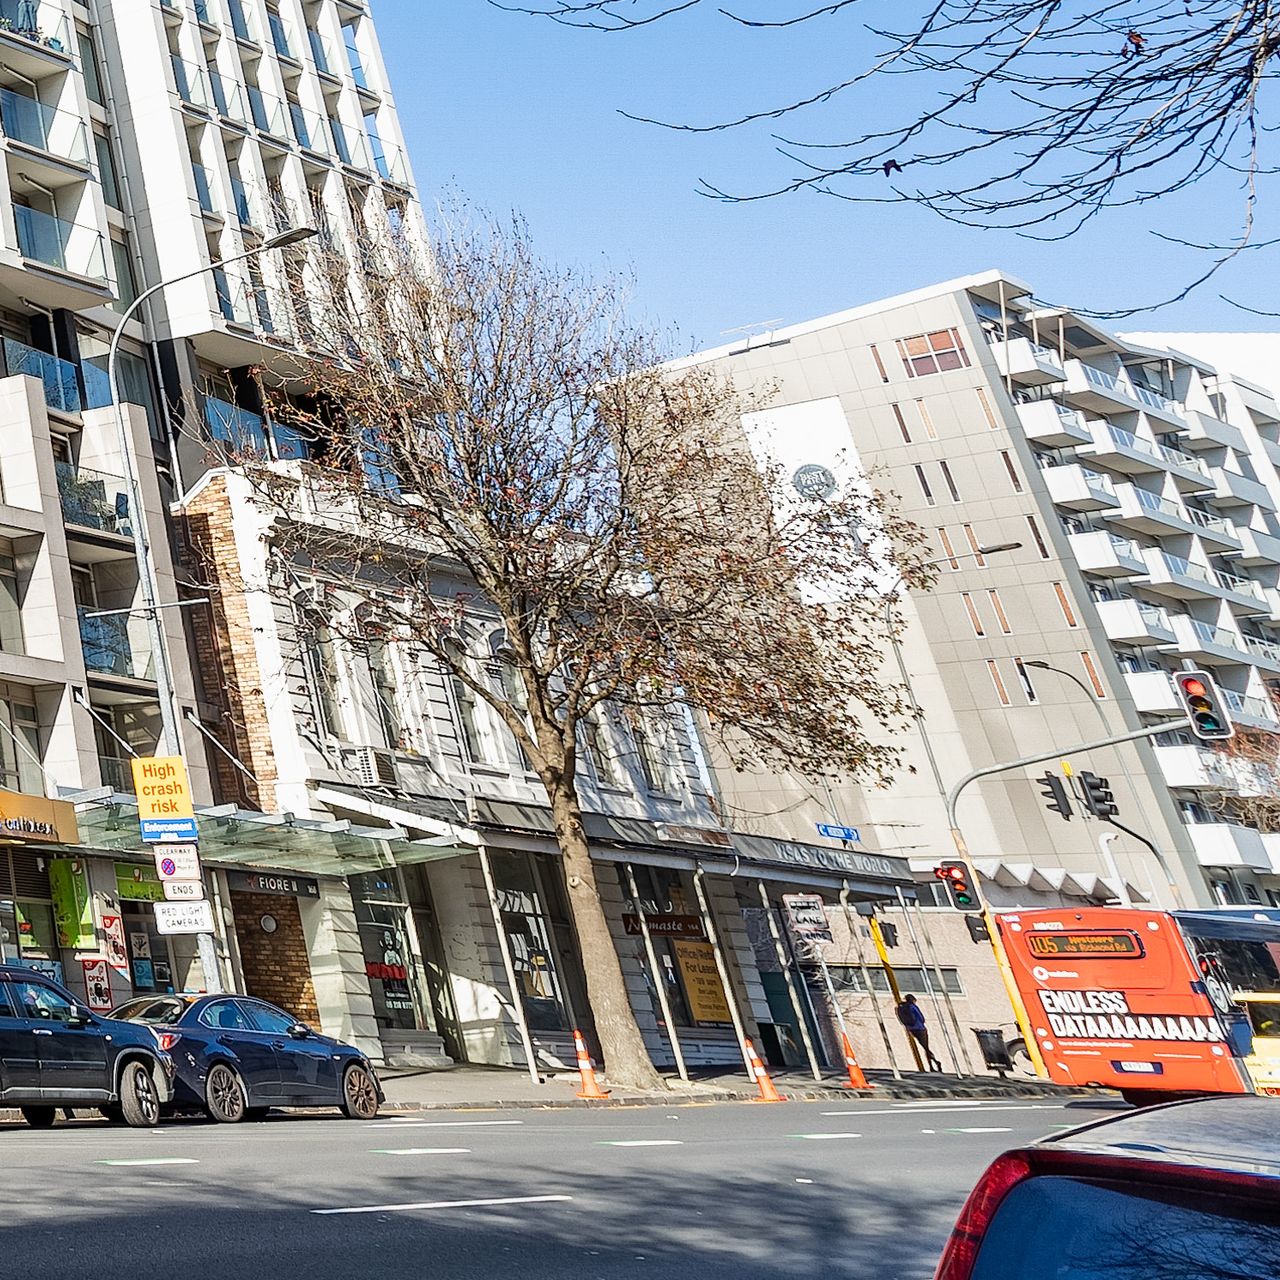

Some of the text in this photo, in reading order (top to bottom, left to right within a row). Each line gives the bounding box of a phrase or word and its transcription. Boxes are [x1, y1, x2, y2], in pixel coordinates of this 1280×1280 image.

[142, 763, 175, 780] High
[142, 781, 183, 796] crash
[151, 799, 179, 813] risk
[144, 822, 192, 832] Enforcement
[773, 843, 892, 875] VISAS TO THE WORLD
[172, 885, 195, 895] ENDS
[259, 877, 290, 891] FIORE
[161, 905, 204, 917] RED LIGHT
[165, 918, 205, 928] CAMERAS
[796, 915, 822, 925] LANE
[1031, 936, 1058, 953] 105
[1040, 990, 1130, 1014] ENDLESS
